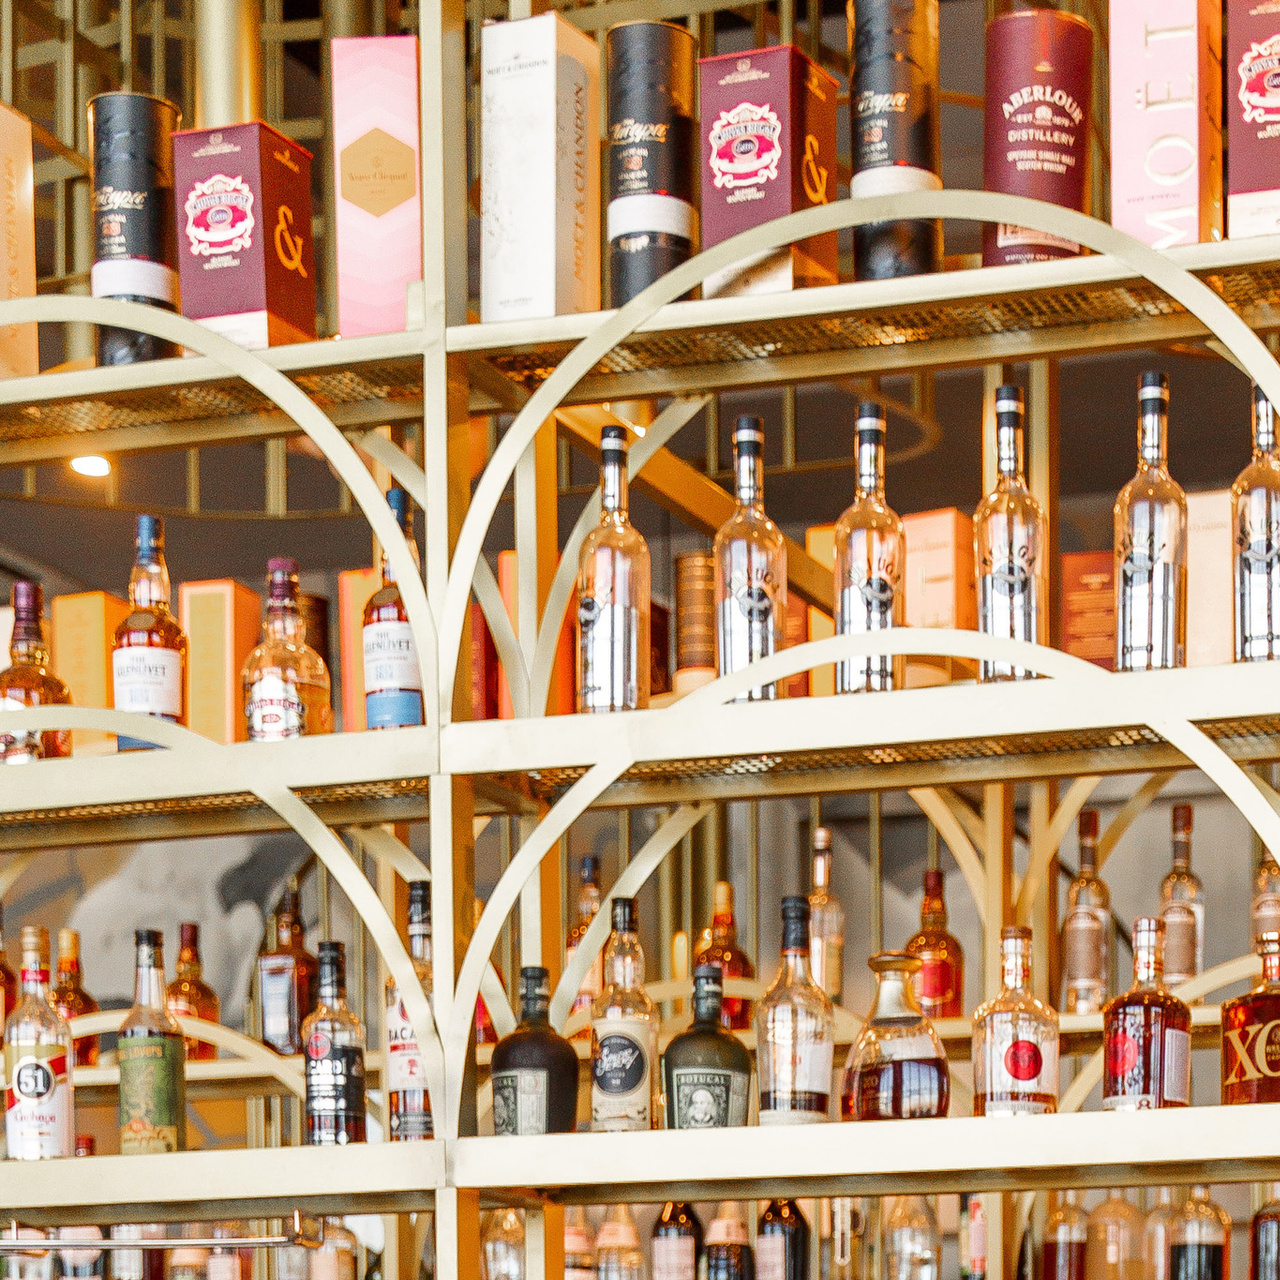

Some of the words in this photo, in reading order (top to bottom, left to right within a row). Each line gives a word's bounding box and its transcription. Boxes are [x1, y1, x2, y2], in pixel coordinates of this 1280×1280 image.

[1002, 85, 1084, 124] ABERLOUR
[1007, 128, 1076, 147] DISTILLERY
[19, 1067, 49, 1094] 51
